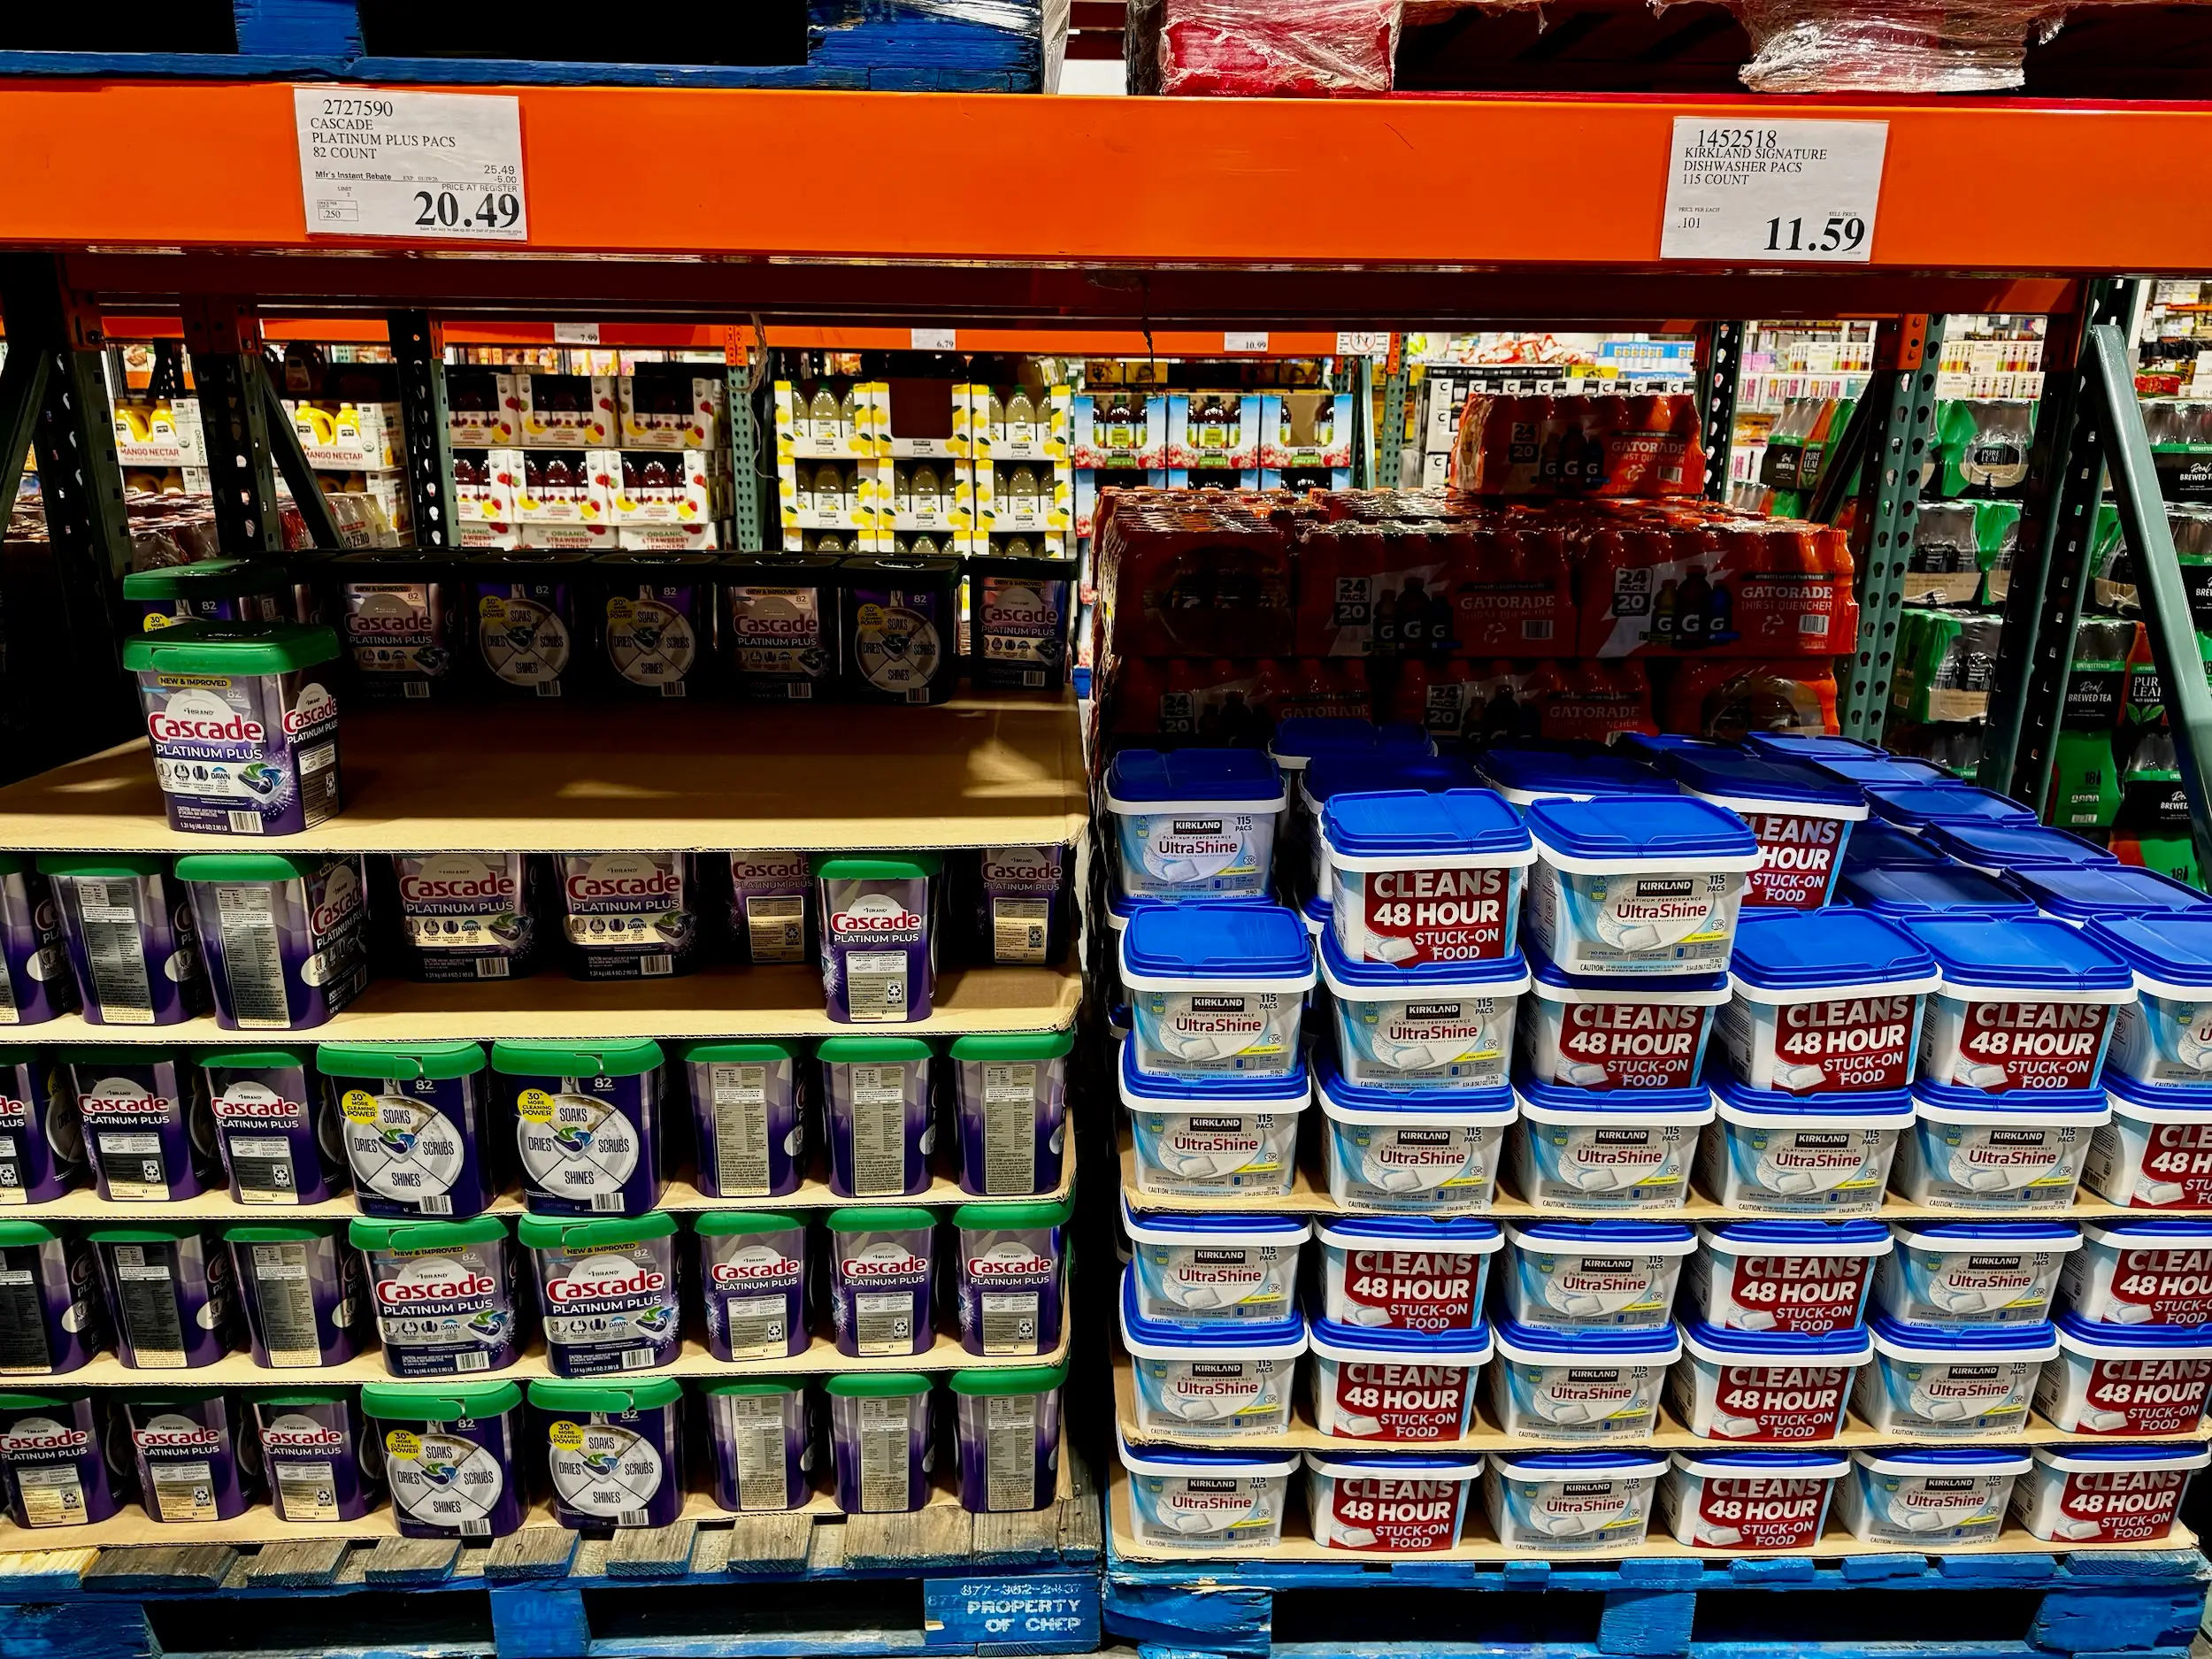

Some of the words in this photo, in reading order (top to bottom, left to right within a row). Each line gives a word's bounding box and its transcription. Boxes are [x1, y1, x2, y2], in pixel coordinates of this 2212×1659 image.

[324, 99, 393, 117] 2727590
[311, 118, 373, 130] CASCADE
[312, 133, 381, 146] PLATINUM
[386, 134, 419, 147] PLUS
[423, 136, 456, 148] PACS
[1698, 129, 1778, 149] 1452518
[313, 147, 326, 157] 82
[331, 148, 376, 159] COUNT
[1686, 147, 1751, 158] KIRKLAND
[1755, 149, 1827, 160] SIGNATURE
[484, 165, 515, 174] 25.49
[1684, 161, 1766, 173] DISHWASHER
[1770, 162, 1802, 173] PACS
[1683, 174, 1701, 185] 115
[1705, 174, 1749, 185] COUNT
[414, 191, 519, 228] 20.49
[1678, 218, 1701, 228] .101
[1763, 217, 1865, 252] 11.59
[937, 340, 954, 349] 6.79
[1245, 342, 1266, 350] 10.99
[1611, 442, 1686, 454] GATORADE
[1981, 448, 2001, 457] PURE
[1618, 570, 1647, 584] 24
[1618, 584, 1646, 593] PACK
[1741, 586, 1832, 599] GATORADE
[202, 600, 218, 611] 82
[1460, 595, 1555, 610] GATORADE
[1617, 595, 1645, 610] 20
[1741, 601, 1775, 611] THIRST
[1778, 600, 1832, 611] QUENCHER
[979, 605, 1058, 625] Cascade
[344, 613, 433, 635] Cascade
[733, 614, 818, 636] Cascade
[349, 635, 403, 646] PLATINUM
[404, 635, 433, 645] PLUS
[186, 678, 228, 687] IMPROVED
[2079, 680, 2104, 693] Real
[2134, 677, 2159, 687] PUR
[227, 689, 242, 700] 82
[282, 695, 337, 735] Cascade
[1281, 704, 1369, 719] GATORADE
[1548, 706, 1640, 718] GATORADE
[149, 711, 264, 742] Cascade
[287, 725, 326, 745] PLATINUM
[155, 743, 223, 759] PLATINUM
[227, 748, 264, 760] PLUS
[211, 772, 231, 780] DAWN
[1175, 820, 1221, 830] KIRKLAND
[1236, 816, 1251, 826] 115
[1158, 841, 1238, 855] UltraShine
[981, 859, 1062, 880] Cascade
[400, 872, 515, 901] Cascade
[1375, 870, 1502, 899] CLEANS
[1639, 879, 1692, 893] KIRKLAND
[1753, 872, 1824, 890] STUCK-ON
[1765, 887, 1807, 903] FOOD
[405, 902, 476, 914] PLATINUM
[480, 901, 515, 912] PLUS
[1372, 902, 1412, 927] 48
[1417, 899, 1500, 926] HOUR
[1616, 902, 1708, 920] UltraShine
[832, 910, 921, 933] Cascade
[833, 934, 890, 944] PLATINUM
[892, 933, 919, 943] PLUS
[1414, 927, 1499, 945] STUCK-ON
[1433, 943, 1480, 962] FOOD
[1572, 1004, 1697, 1030] CLEANS
[1568, 1031, 1606, 1053] 48
[1610, 1033, 1692, 1056] HOUR
[1606, 1059, 1689, 1073] STUCK-ON
[415, 1079, 434, 1090] 82
[1622, 1073, 1669, 1087] FOOD
[78, 1094, 170, 1114] Cascade
[83, 1116, 138, 1125] PLATINUM
[141, 1115, 170, 1125] PLUS
[383, 1110, 411, 1125] SOAKS
[1192, 1118, 1240, 1128] KIRKLAND
[1993, 1131, 2043, 1141] KIRKLAND
[2060, 1126, 2077, 1137] 115
[1174, 1136, 1258, 1152] UltraShine
[2057, 1135, 2075, 1144] PACS
[354, 1138, 378, 1153] DRIES
[423, 1141, 454, 1156] SCRUBS
[1969, 1149, 2056, 1165] UltraShine
[391, 1172, 421, 1187] SHINES
[592, 1242, 635, 1254] IMPROVED
[712, 1257, 800, 1283] Cascade
[547, 1272, 664, 1303] Cascade
[552, 1302, 623, 1315] PLATINUM
[626, 1295, 662, 1308] PLUS
[1176, 1381, 1258, 1395] UltraShine
[2094, 1383, 2130, 1401] 48
[2132, 1382, 2202, 1404] HOUR
[2127, 1403, 2199, 1418] STUCK-ON
[588, 1436, 615, 1449] SOAKS
[559, 1462, 581, 1475] DRIES
[625, 1462, 654, 1476] SCRUBS
[1189, 1479, 1235, 1489] KIRKLAND
[1342, 1480, 1454, 1501] CLEANS
[593, 1491, 621, 1503] SHINES
[967, 1600, 1081, 1614] PROPERTY
[985, 1618, 1016, 1632] OF
[1025, 1617, 1081, 1632] CHEP
